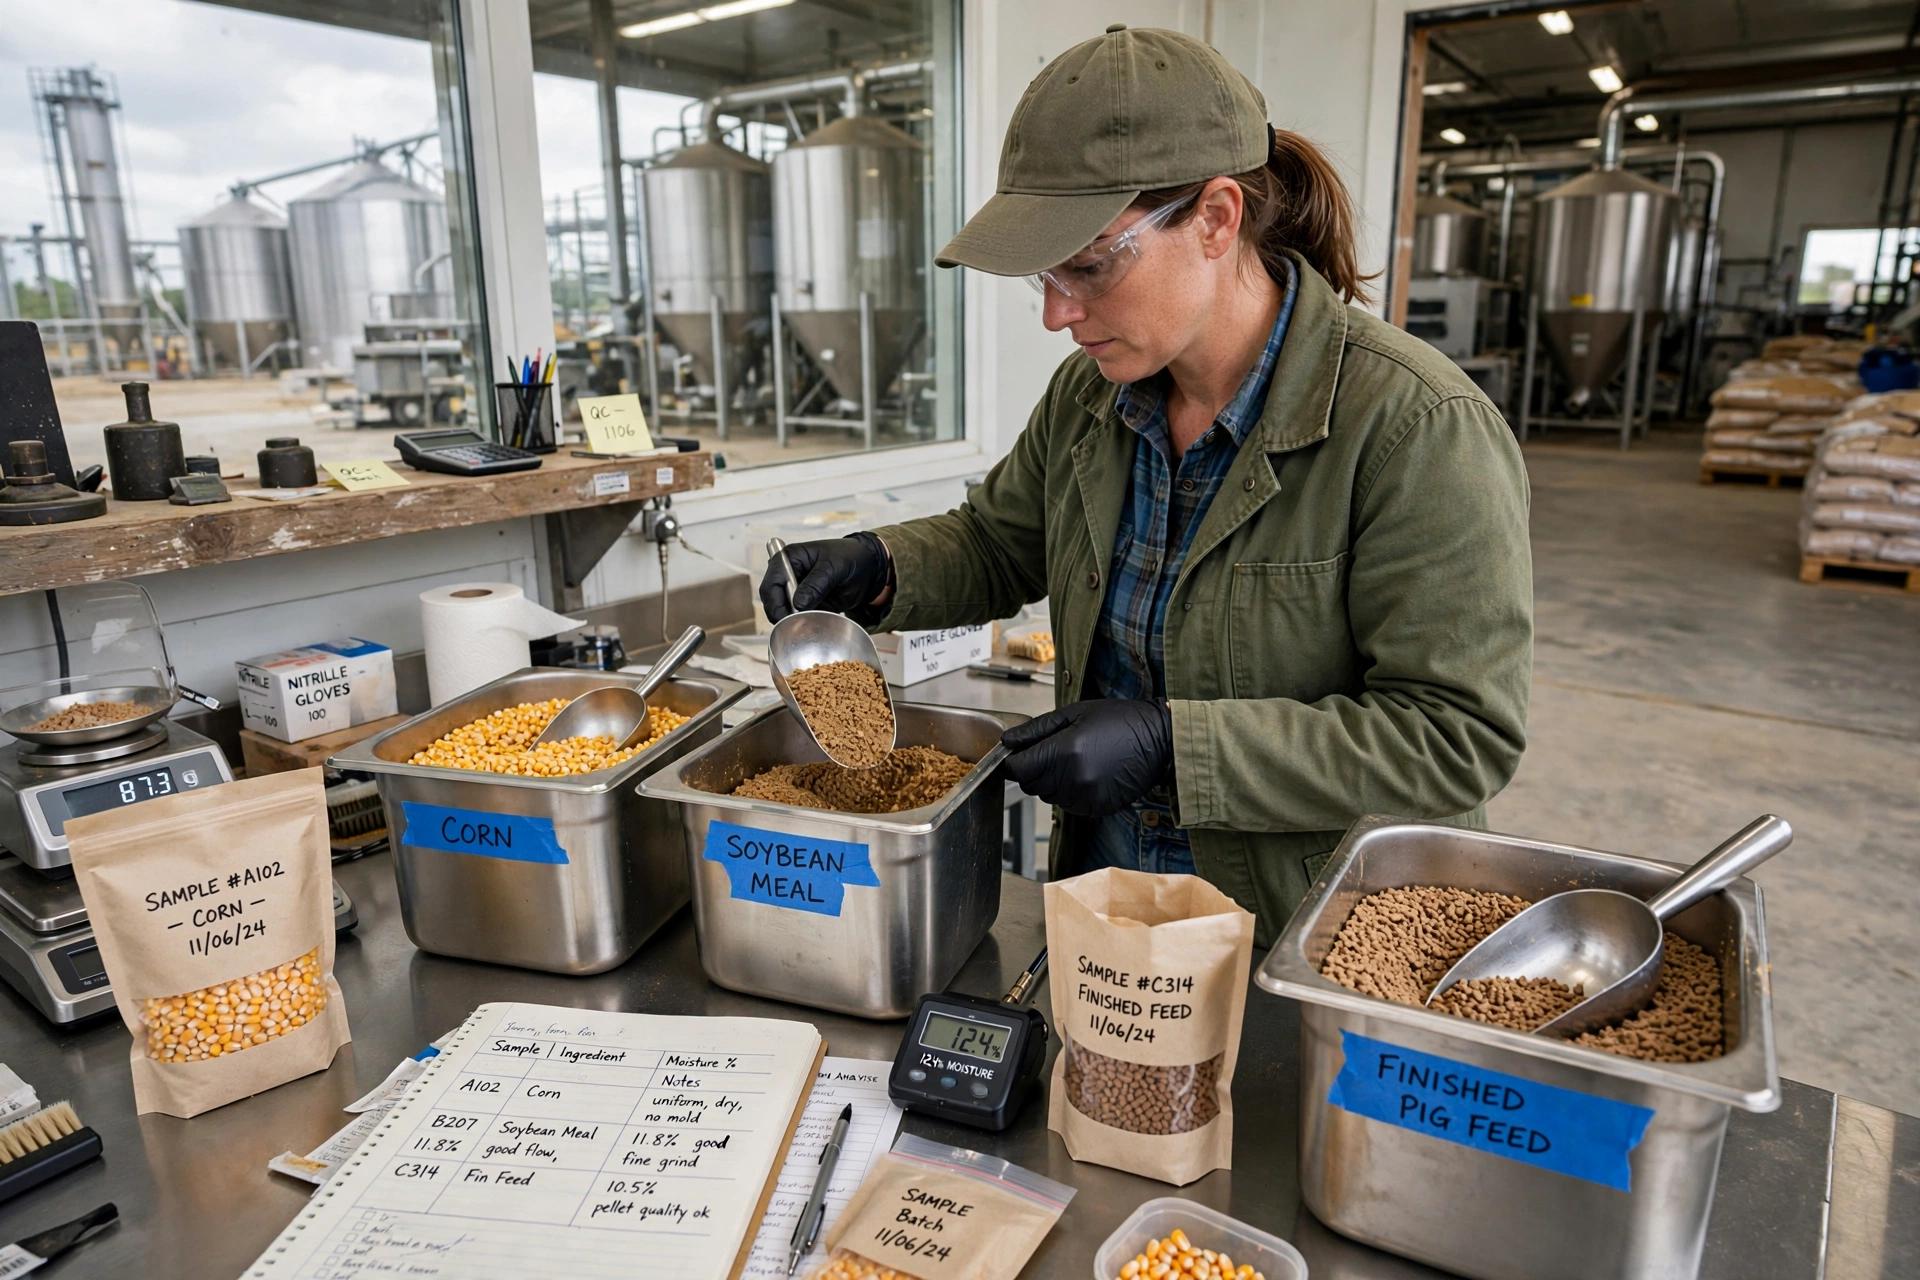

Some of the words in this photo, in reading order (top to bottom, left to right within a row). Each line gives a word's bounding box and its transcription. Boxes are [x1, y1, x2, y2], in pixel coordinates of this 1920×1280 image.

[590, 406, 611, 420] QC
[604, 424, 636, 440] 1106
[922, 652, 928, 662] L
[288, 665, 349, 690] NITRILLE
[295, 682, 351, 707] GLOVES
[245, 707, 251, 719] L
[264, 714, 278, 728] 100
[308, 708, 327, 722] 100
[119, 772, 171, 803] 87.3
[441, 815, 512, 848] CORN
[726, 834, 845, 873] SOYBEAN
[145, 877, 220, 912] SAMPLE
[226, 861, 285, 889] #A102
[750, 872, 825, 903] MEAL
[192, 900, 243, 928] CORN
[188, 919, 266, 957] 11/06/24
[1077, 955, 1130, 988] SAMPLE
[1136, 975, 1194, 994] #C314
[1078, 983, 1143, 1017] FINISHED
[1149, 1003, 1193, 1020] FEED
[1089, 1014, 1156, 1044] 11/06/24
[492, 1039, 541, 1057] Sample
[559, 1046, 627, 1064] Ingredient
[665, 1055, 719, 1068] Moisture
[725, 1057, 738, 1069] %
[946, 1060, 995, 1080] MOISTURE
[460, 1079, 501, 1093] A102
[661, 1074, 701, 1088] Notes
[1377, 1053, 1525, 1112] FINISHED
[526, 1085, 561, 1100] Corn
[652, 1094, 708, 1111] uniform,
[715, 1095, 743, 1115] dry,
[431, 1114, 478, 1131] B207
[644, 1113, 661, 1122] no
[667, 1110, 702, 1124] mold
[1399, 1094, 1451, 1131] PIG
[1467, 1114, 1551, 1154] FEED
[498, 1121, 556, 1140] Soybean
[561, 1126, 599, 1140] Meal
[413, 1137, 462, 1152] 11.8%
[481, 1142, 522, 1159] good
[524, 1142, 558, 1163] flow,
[632, 1132, 680, 1148] 11.8%
[692, 1134, 731, 1153] good
[394, 1163, 440, 1180] C314
[622, 1151, 652, 1166] fine
[656, 1155, 701, 1173] grind
[463, 1168, 489, 1183] Fin
[495, 1171, 536, 1186] Feed
[606, 1180, 658, 1195] 10.5%
[590, 1199, 635, 1218] pellet
[639, 1203, 688, 1224] quality
[693, 1205, 711, 1219] ok
[901, 1188, 974, 1218] SAMPLE
[895, 1208, 944, 1233] Batch
[873, 1227, 952, 1263] 11/06/24
